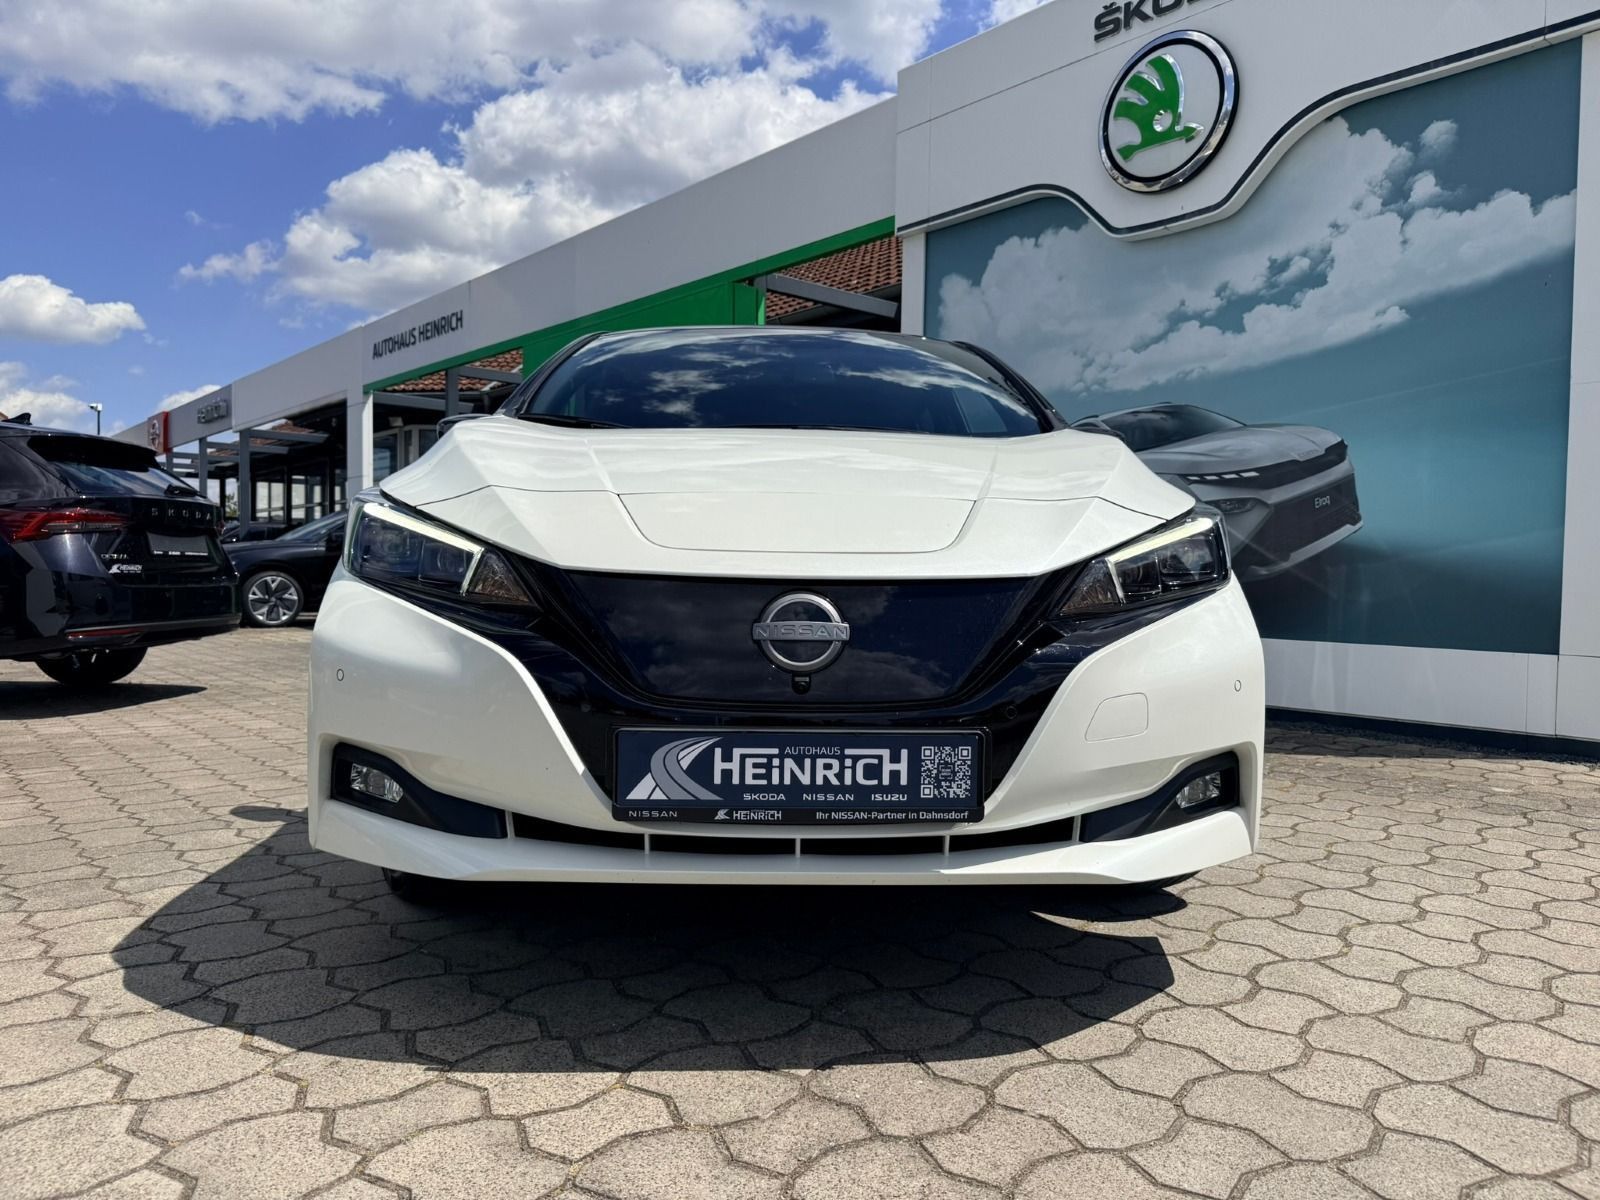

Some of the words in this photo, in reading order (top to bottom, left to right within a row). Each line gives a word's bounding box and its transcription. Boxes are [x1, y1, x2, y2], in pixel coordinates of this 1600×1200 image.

[372, 327, 417, 360] AUTOHAUS
[418, 309, 464, 343] HEINRICH
[755, 624, 848, 640] NISSAN
[784, 746, 841, 756] AUTOHAUS
[802, 793, 854, 801] NISSAN
[628, 810, 678, 818] NISSAN
[816, 811, 830, 820] Ihr
[831, 811, 906, 820] NISSAN-Partner
[908, 811, 917, 820] in
[919, 811, 969, 820] Dahnsdorf
